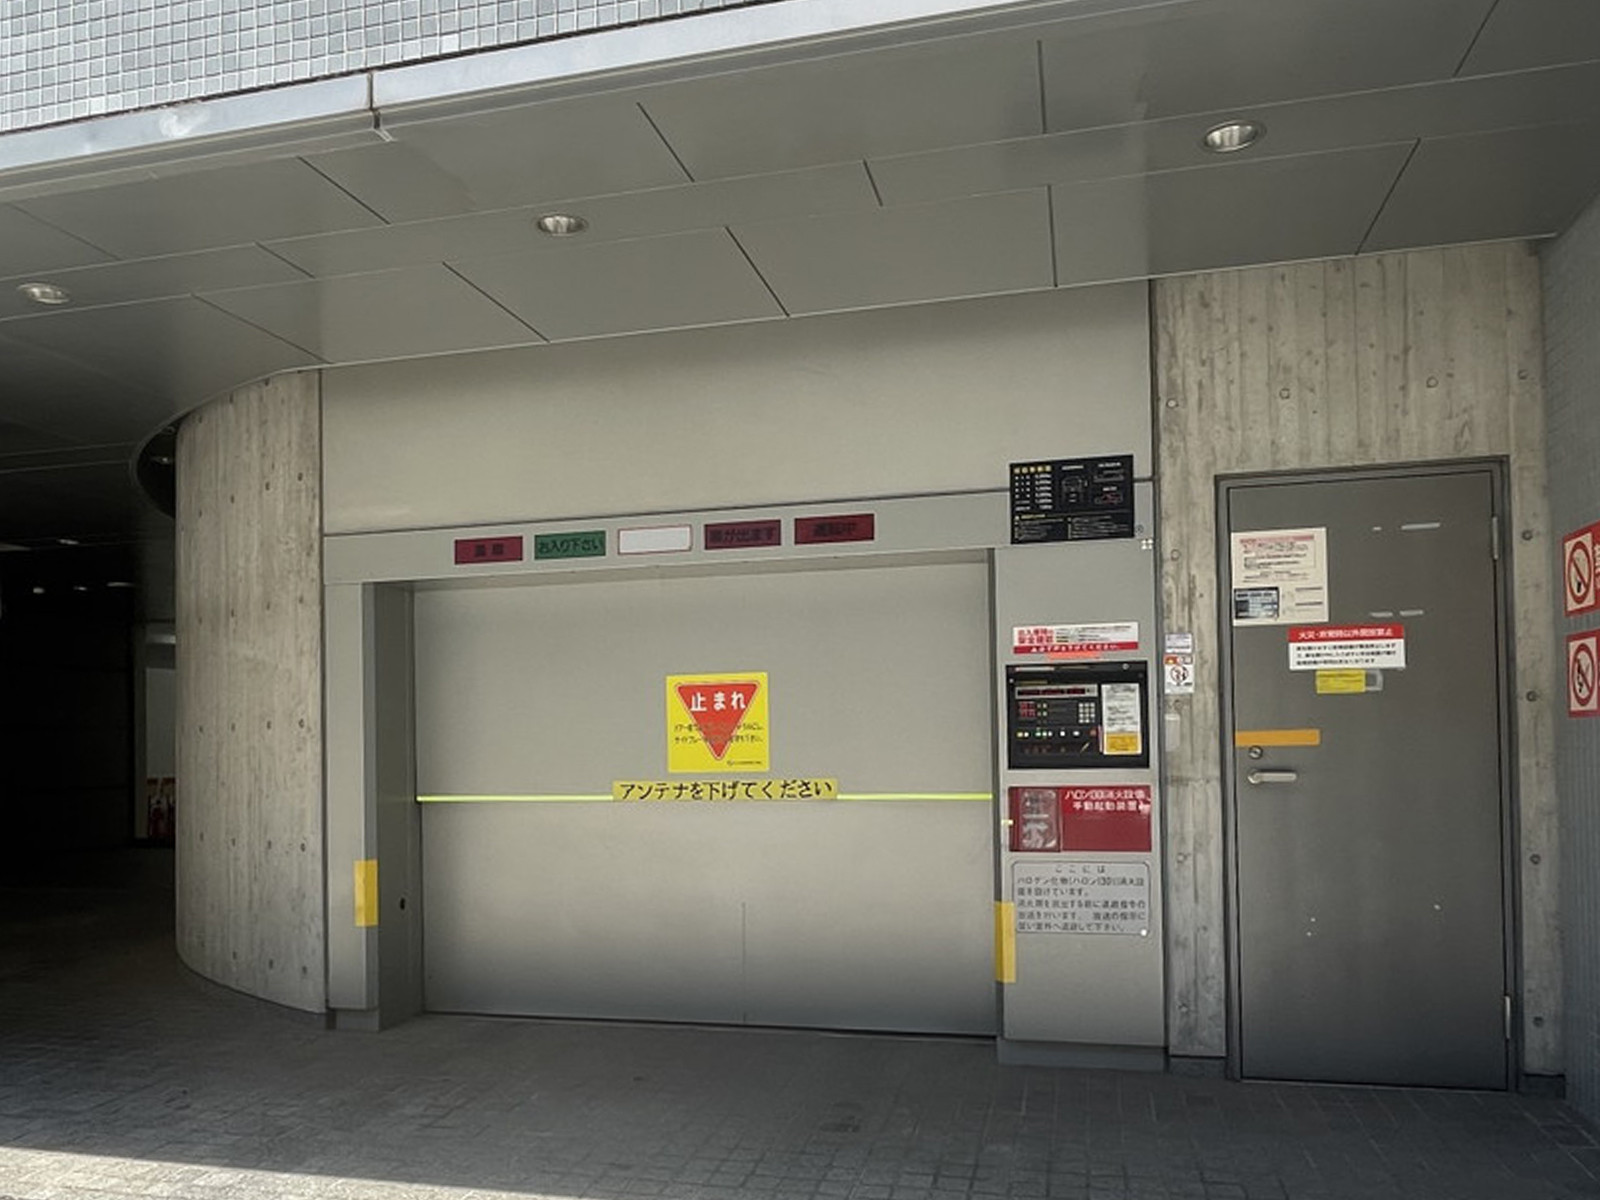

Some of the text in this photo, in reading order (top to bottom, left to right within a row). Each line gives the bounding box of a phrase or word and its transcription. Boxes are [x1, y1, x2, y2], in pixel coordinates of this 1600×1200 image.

[709, 526, 776, 545] が出ます
[538, 537, 603, 553] お入り下さい
[690, 690, 746, 712] 止まれ
[619, 778, 833, 801] アンテナを下げてください
[1072, 800, 1138, 811] 手動起動装置
[1055, 865, 1106, 874] ここには
